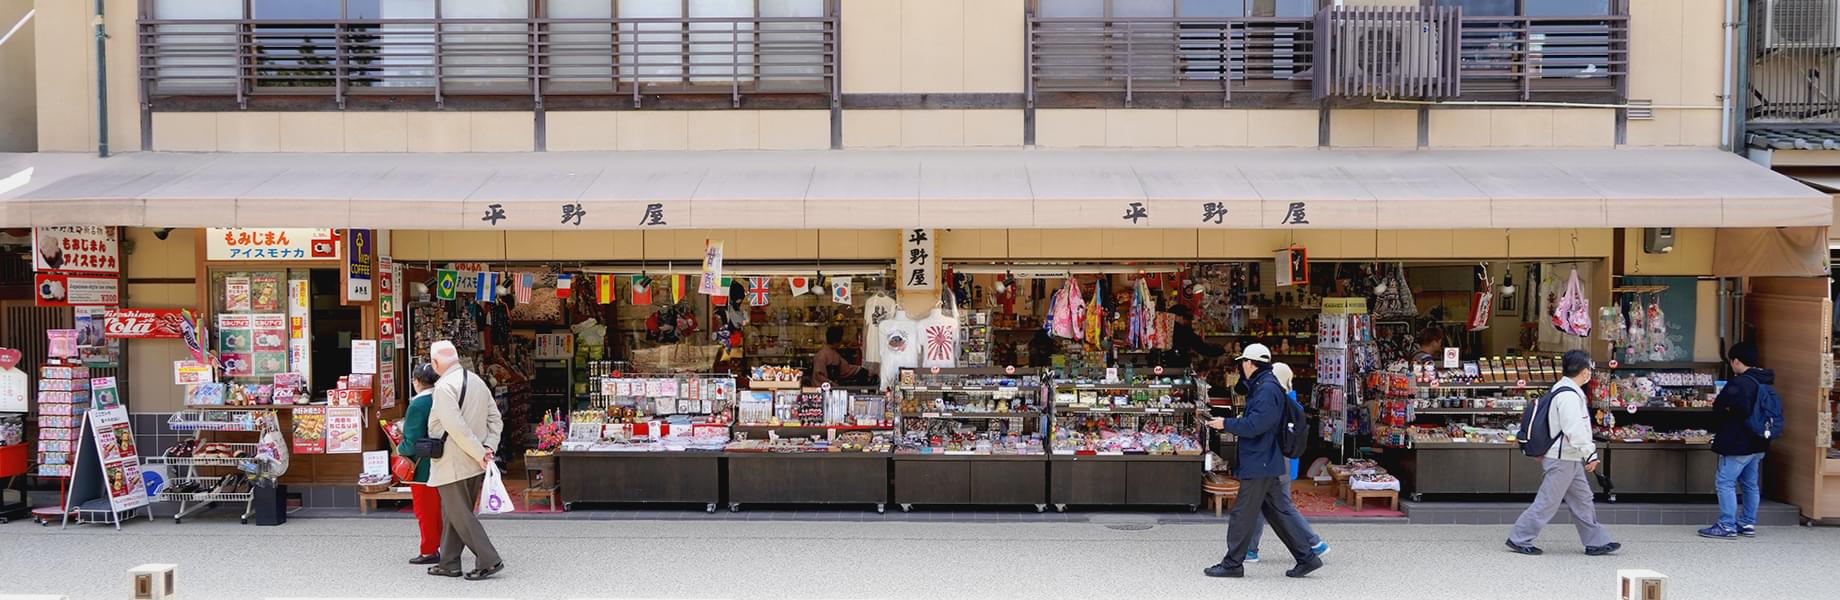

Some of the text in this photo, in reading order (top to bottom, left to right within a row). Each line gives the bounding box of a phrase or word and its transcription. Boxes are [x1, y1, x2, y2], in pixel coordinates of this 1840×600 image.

[481, 203, 667, 226] 平野屋
[1122, 202, 1310, 225] 平野屋
[63, 237, 106, 253] もみじまん
[224, 231, 289, 246] もみじまん
[63, 253, 116, 269] アイスモナカ
[230, 248, 305, 258] アイスモナカ
[907, 228, 928, 286] 平野屋
[351, 263, 370, 276] COFFEE
